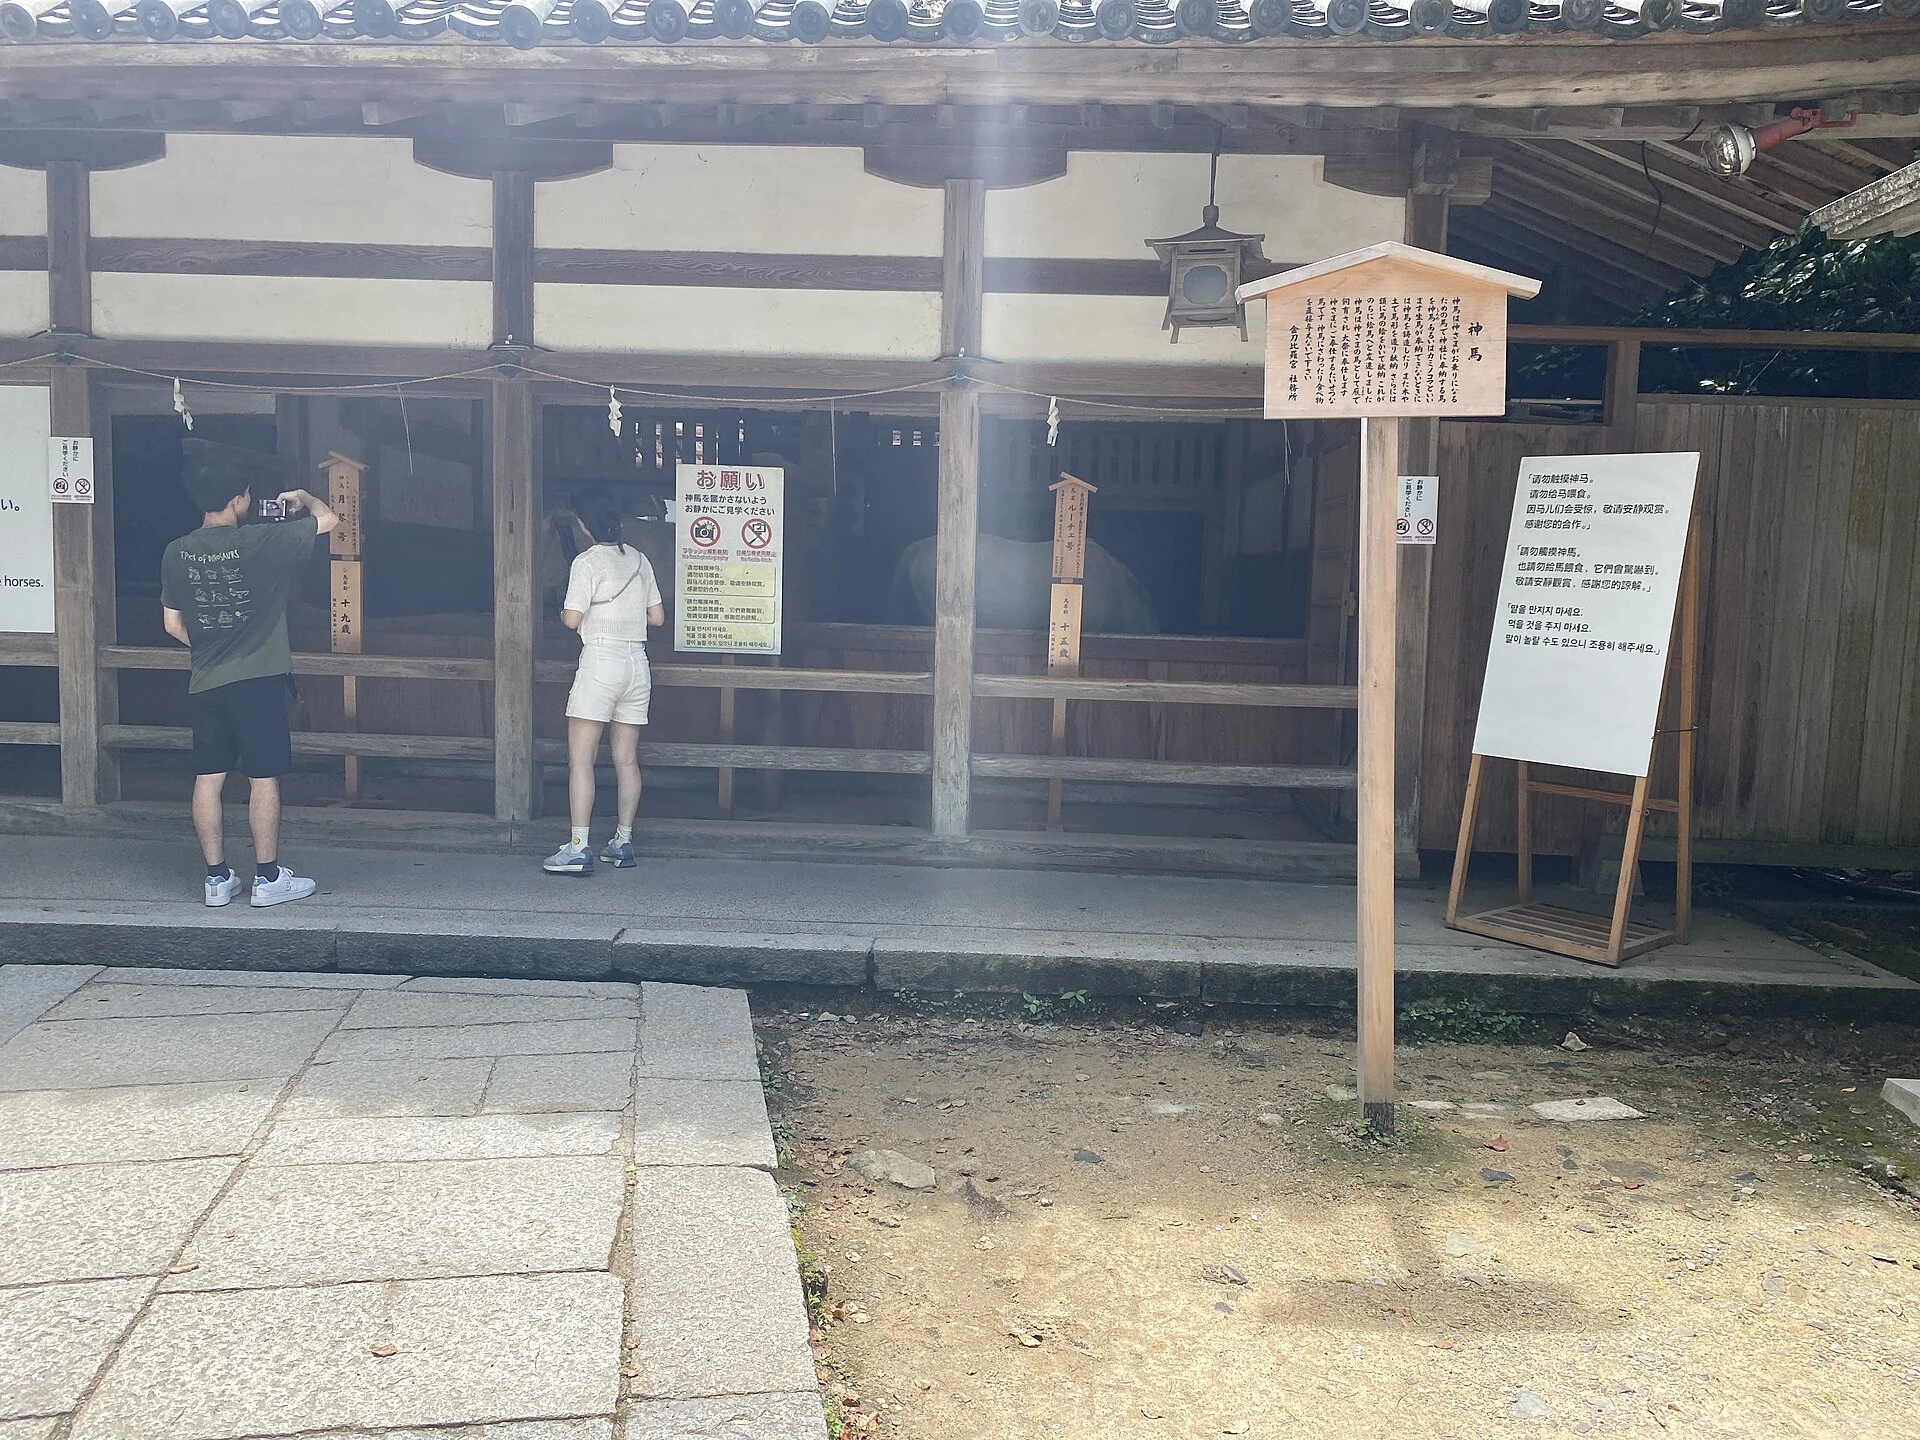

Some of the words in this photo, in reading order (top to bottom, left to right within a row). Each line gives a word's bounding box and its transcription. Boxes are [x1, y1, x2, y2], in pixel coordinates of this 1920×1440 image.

[1467, 321, 1483, 362] 神馬
[1288, 374, 1299, 402] 社務所
[696, 469, 766, 491] お願い
[685, 494, 767, 504] 神馬を驚かさないよう
[685, 505, 775, 516] お静かにご見学ください
[5, 575, 44, 588] horses.
[1528, 605, 1553, 616] 만지지
[1508, 620, 1524, 630] 먹을
[1526, 621, 1543, 631] 것을
[1544, 622, 1561, 632] 주지
[1563, 623, 1592, 633] 마세요.
[1505, 634, 1521, 645] 말이
[1523, 636, 1540, 646] 놀랄
[1542, 637, 1559, 647] 수도
[1561, 639, 1586, 649] 있으니
[1589, 641, 1615, 651] 조용히
